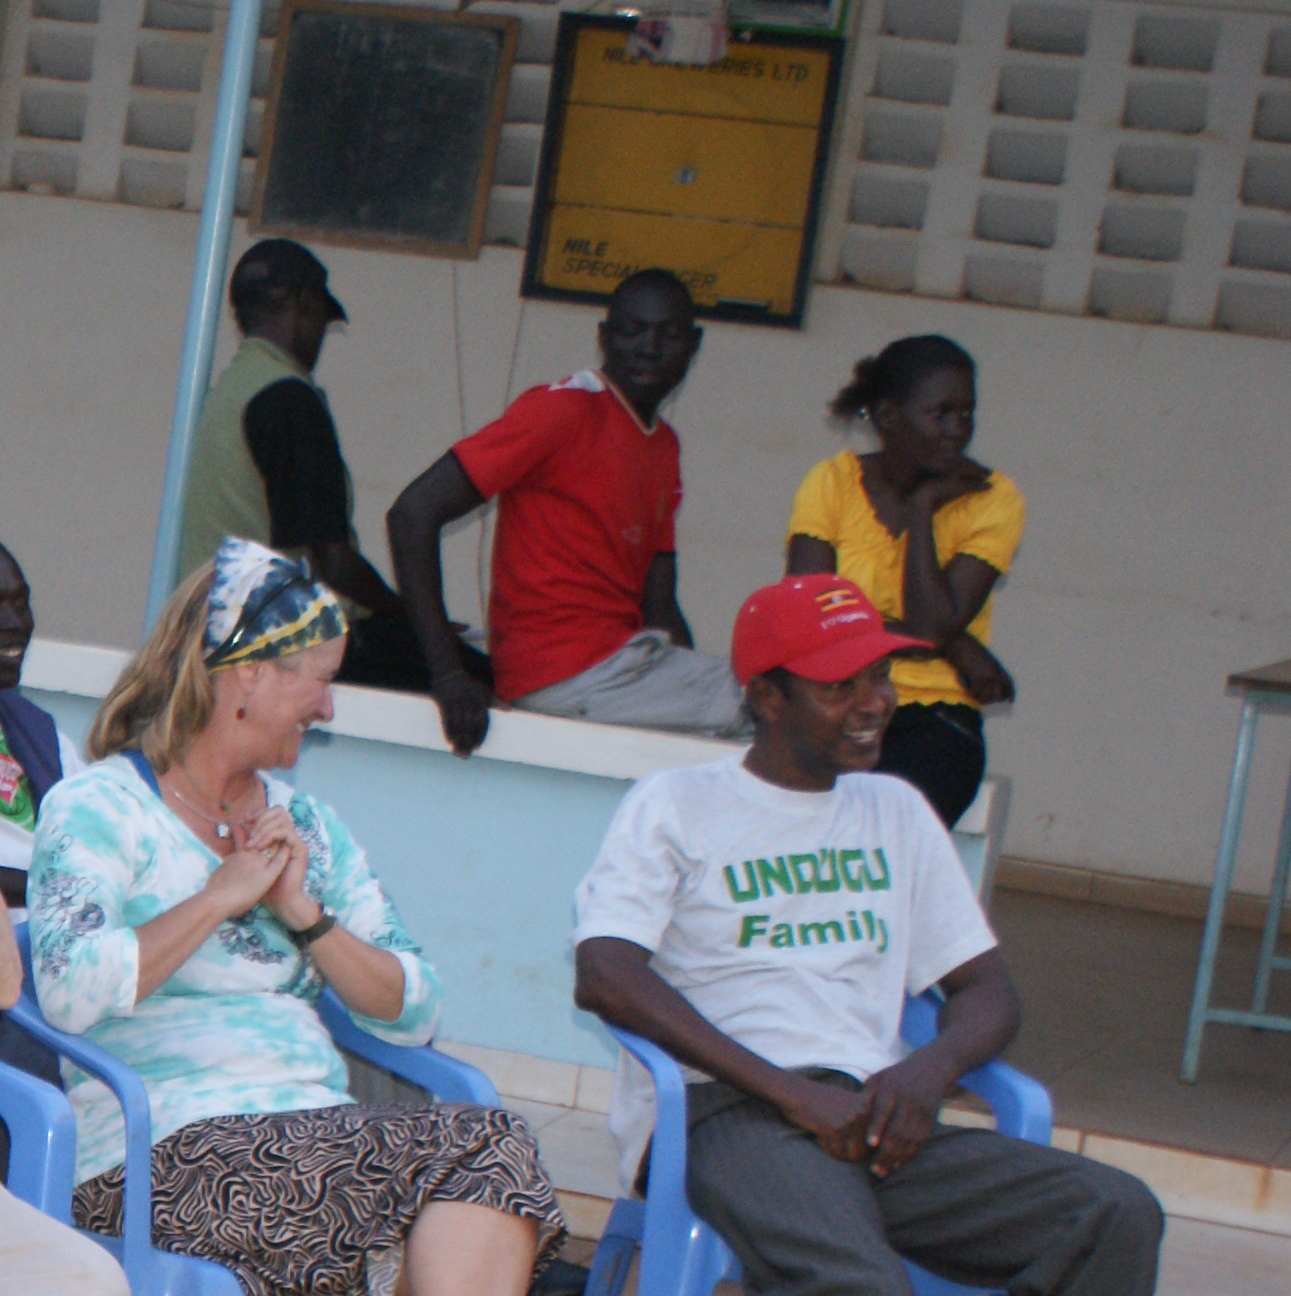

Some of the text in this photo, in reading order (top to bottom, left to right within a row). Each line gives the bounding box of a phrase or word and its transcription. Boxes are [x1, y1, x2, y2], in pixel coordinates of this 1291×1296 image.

[562, 238, 610, 257] NILE
[561, 257, 641, 280] SPECIA
[722, 847, 891, 903] UNDUGU
